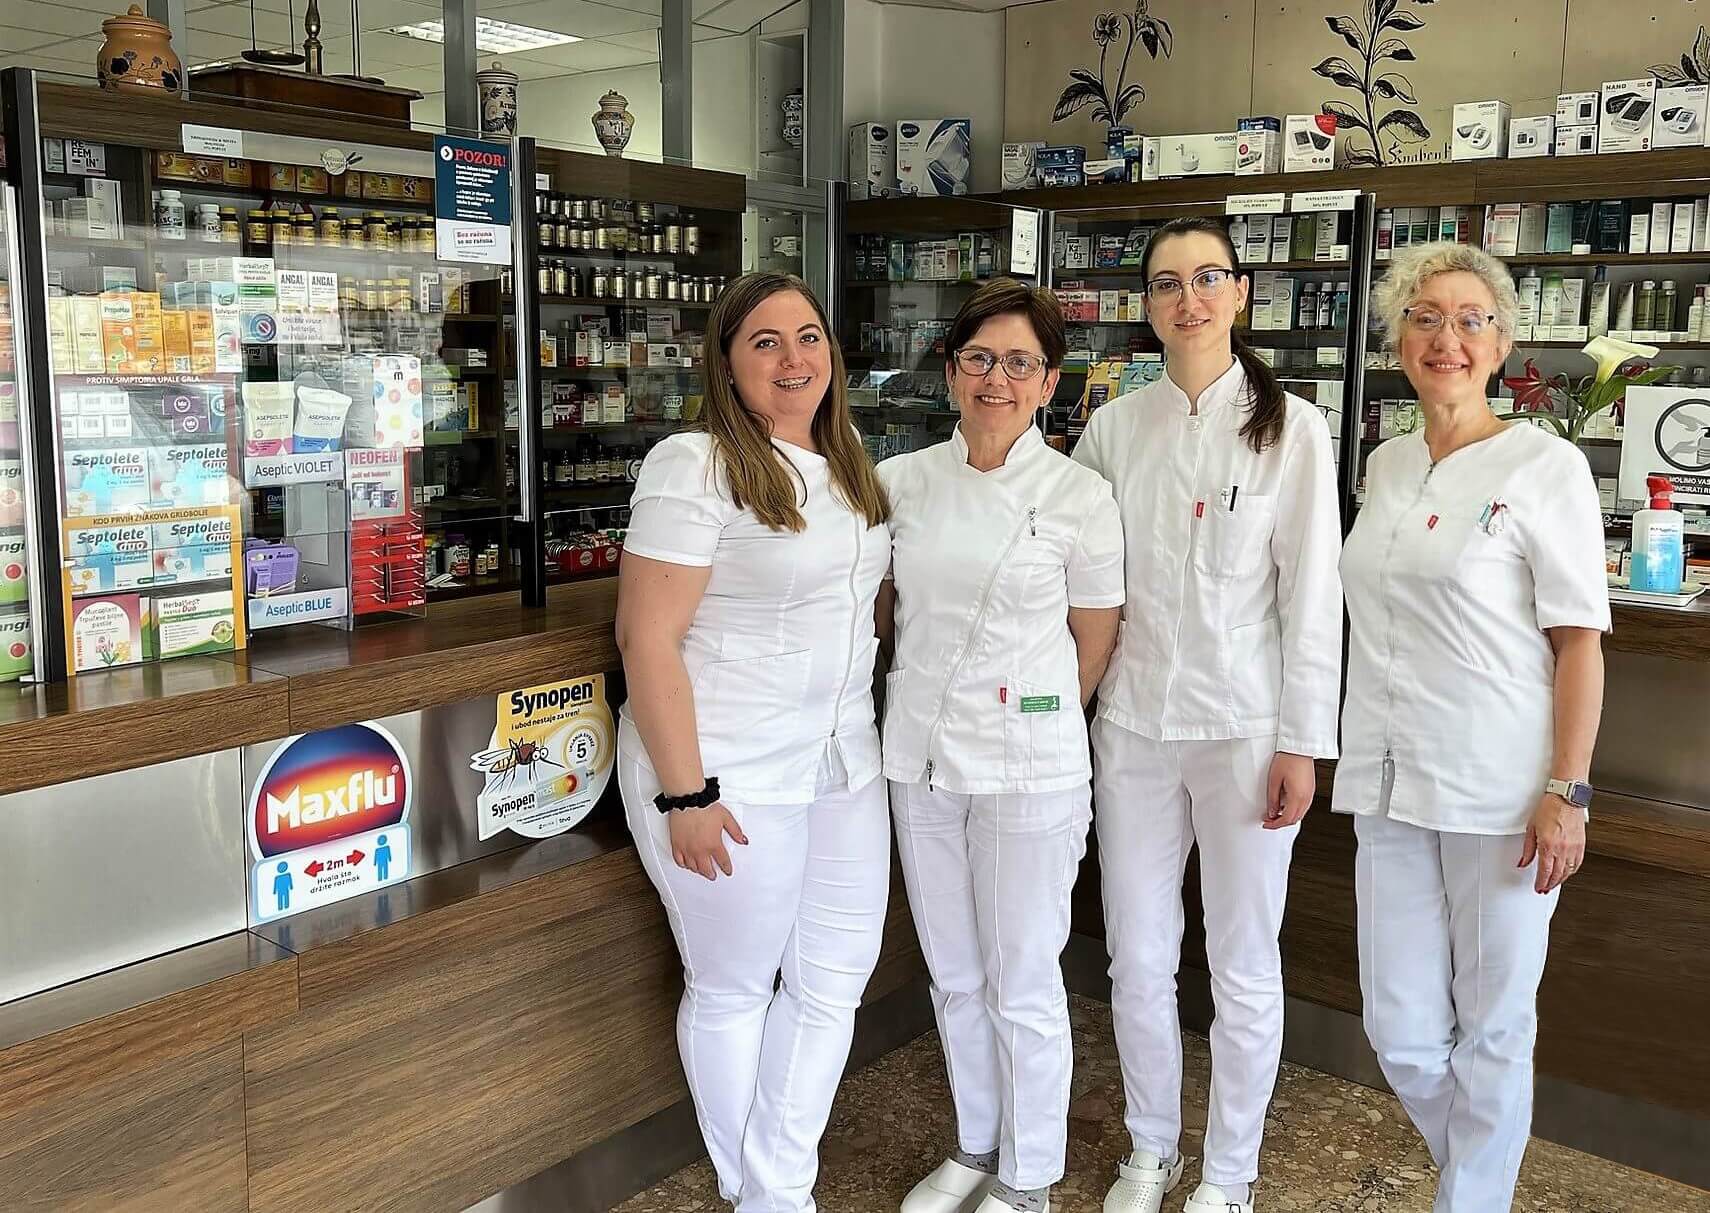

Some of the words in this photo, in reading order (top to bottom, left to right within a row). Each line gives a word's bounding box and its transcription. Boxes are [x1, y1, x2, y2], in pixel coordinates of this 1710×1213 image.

[72, 149, 92, 157] FEM
[454, 149, 506, 167] POZOR!
[72, 452, 140, 468] Septolete
[167, 449, 227, 463] Septolete
[350, 452, 398, 465] NEOFEN
[254, 463, 293, 478] Aseptic
[295, 460, 334, 474] VIOLET
[170, 520, 231, 537] Septolete
[77, 529, 145, 546] Septolete
[266, 602, 303, 617] Aseptic
[305, 597, 332, 611] BLUE
[511, 682, 593, 718] Synopen
[515, 720, 532, 730] ubod
[533, 714, 556, 726] nestaje
[577, 742, 586, 758] 5
[266, 770, 397, 834] Maxflu
[491, 793, 535, 818] Synopen
[326, 859, 344, 871] 2m
[317, 874, 339, 885] Hvala
[333, 875, 360, 887] razmak
